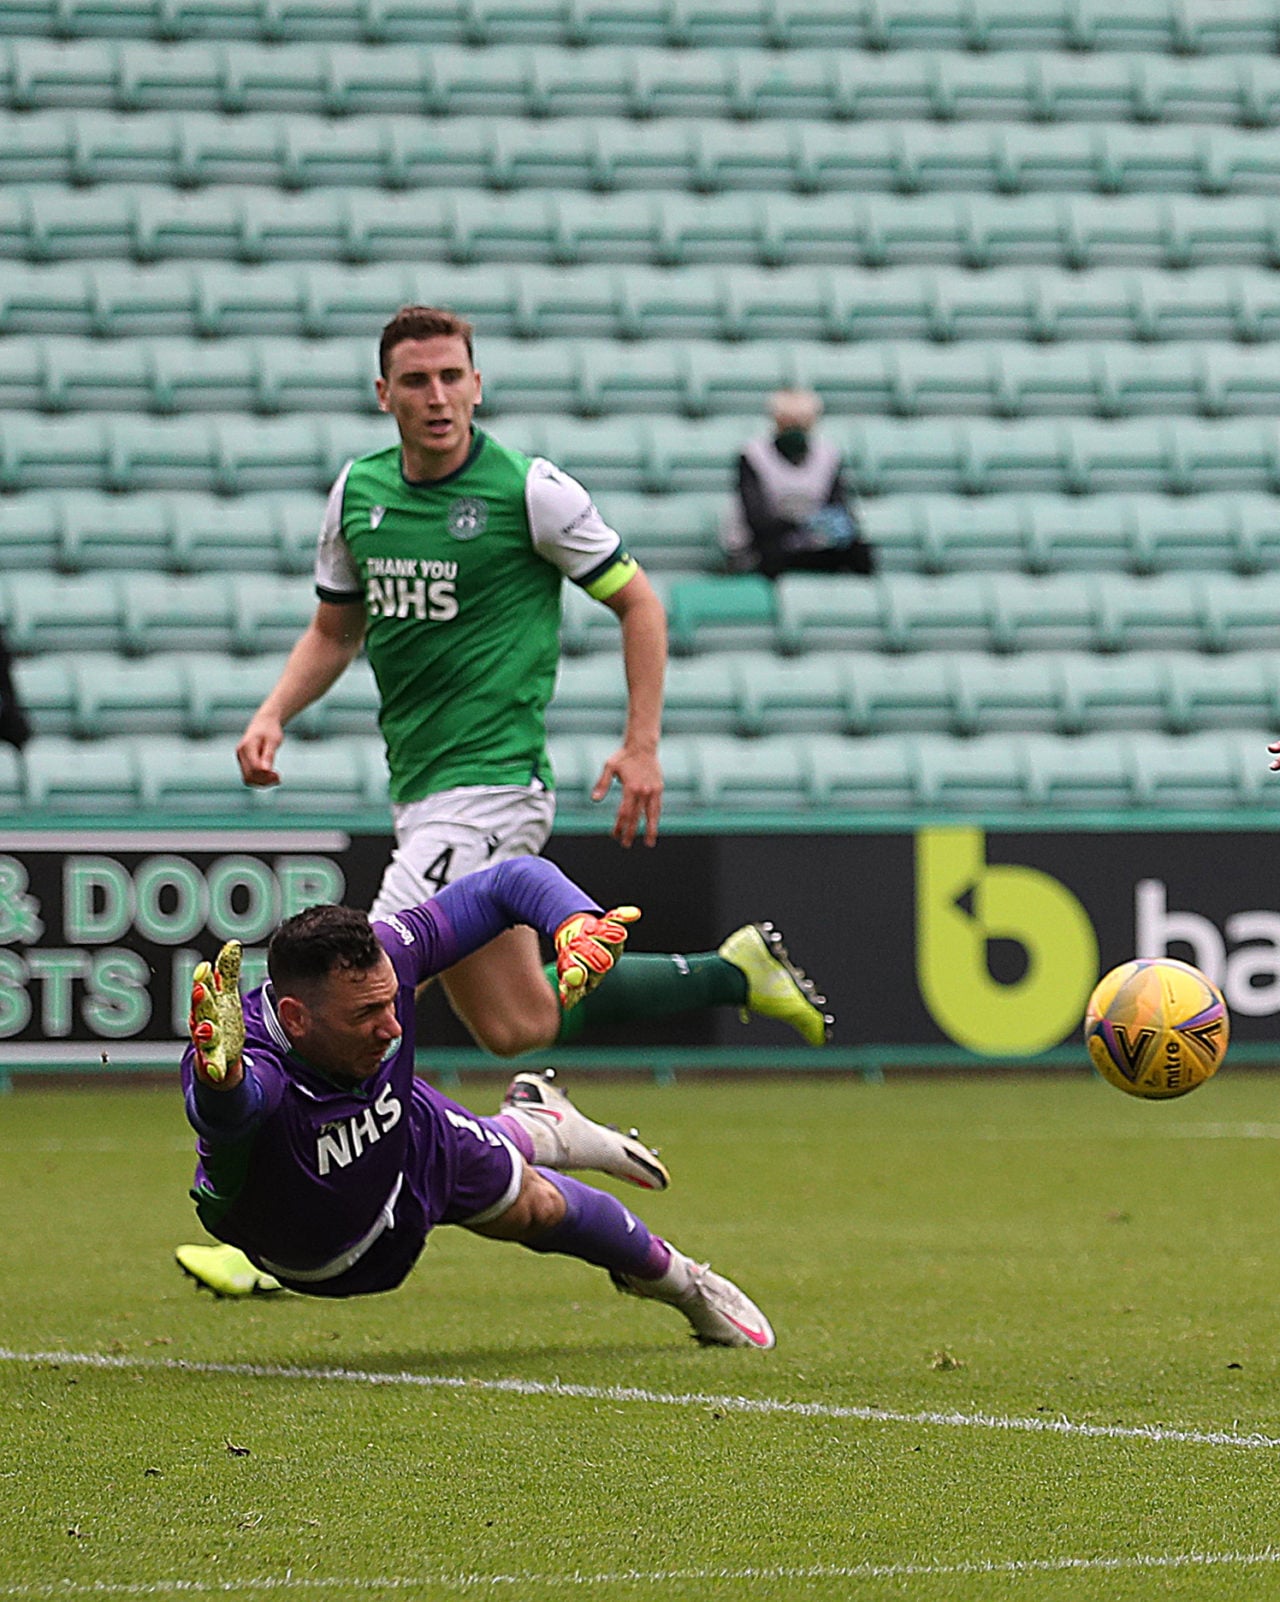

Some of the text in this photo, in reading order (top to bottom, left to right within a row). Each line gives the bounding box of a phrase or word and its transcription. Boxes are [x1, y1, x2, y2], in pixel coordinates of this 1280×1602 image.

[367, 557, 458, 580] THANK YOU
[367, 578, 459, 621] NHS
[423, 847, 454, 894] 4
[1164, 1042, 1181, 1088] mitre
[316, 1083, 402, 1176] NHS
